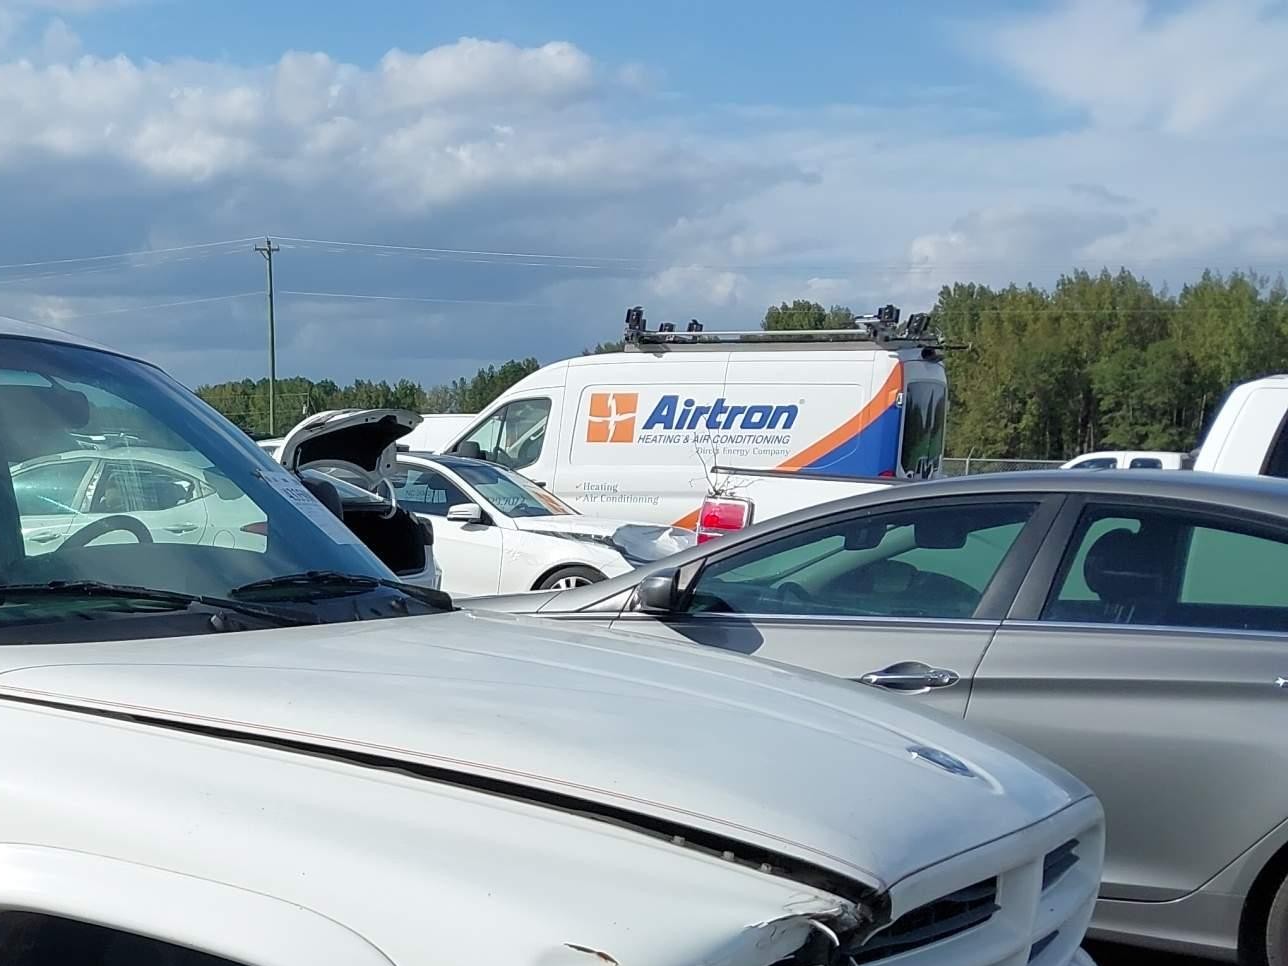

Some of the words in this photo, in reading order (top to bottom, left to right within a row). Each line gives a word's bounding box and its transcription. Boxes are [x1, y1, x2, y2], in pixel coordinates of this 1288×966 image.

[642, 394, 799, 430] Airtron
[637, 434, 681, 444] HEATING
[682, 434, 689, 444] &
[692, 434, 711, 444] AIR
[712, 434, 791, 444] CONDITIONING
[752, 446, 790, 457] Company
[583, 482, 619, 493] Heating
[582, 493, 598, 503] Air
[600, 494, 660, 505] Conditioning
